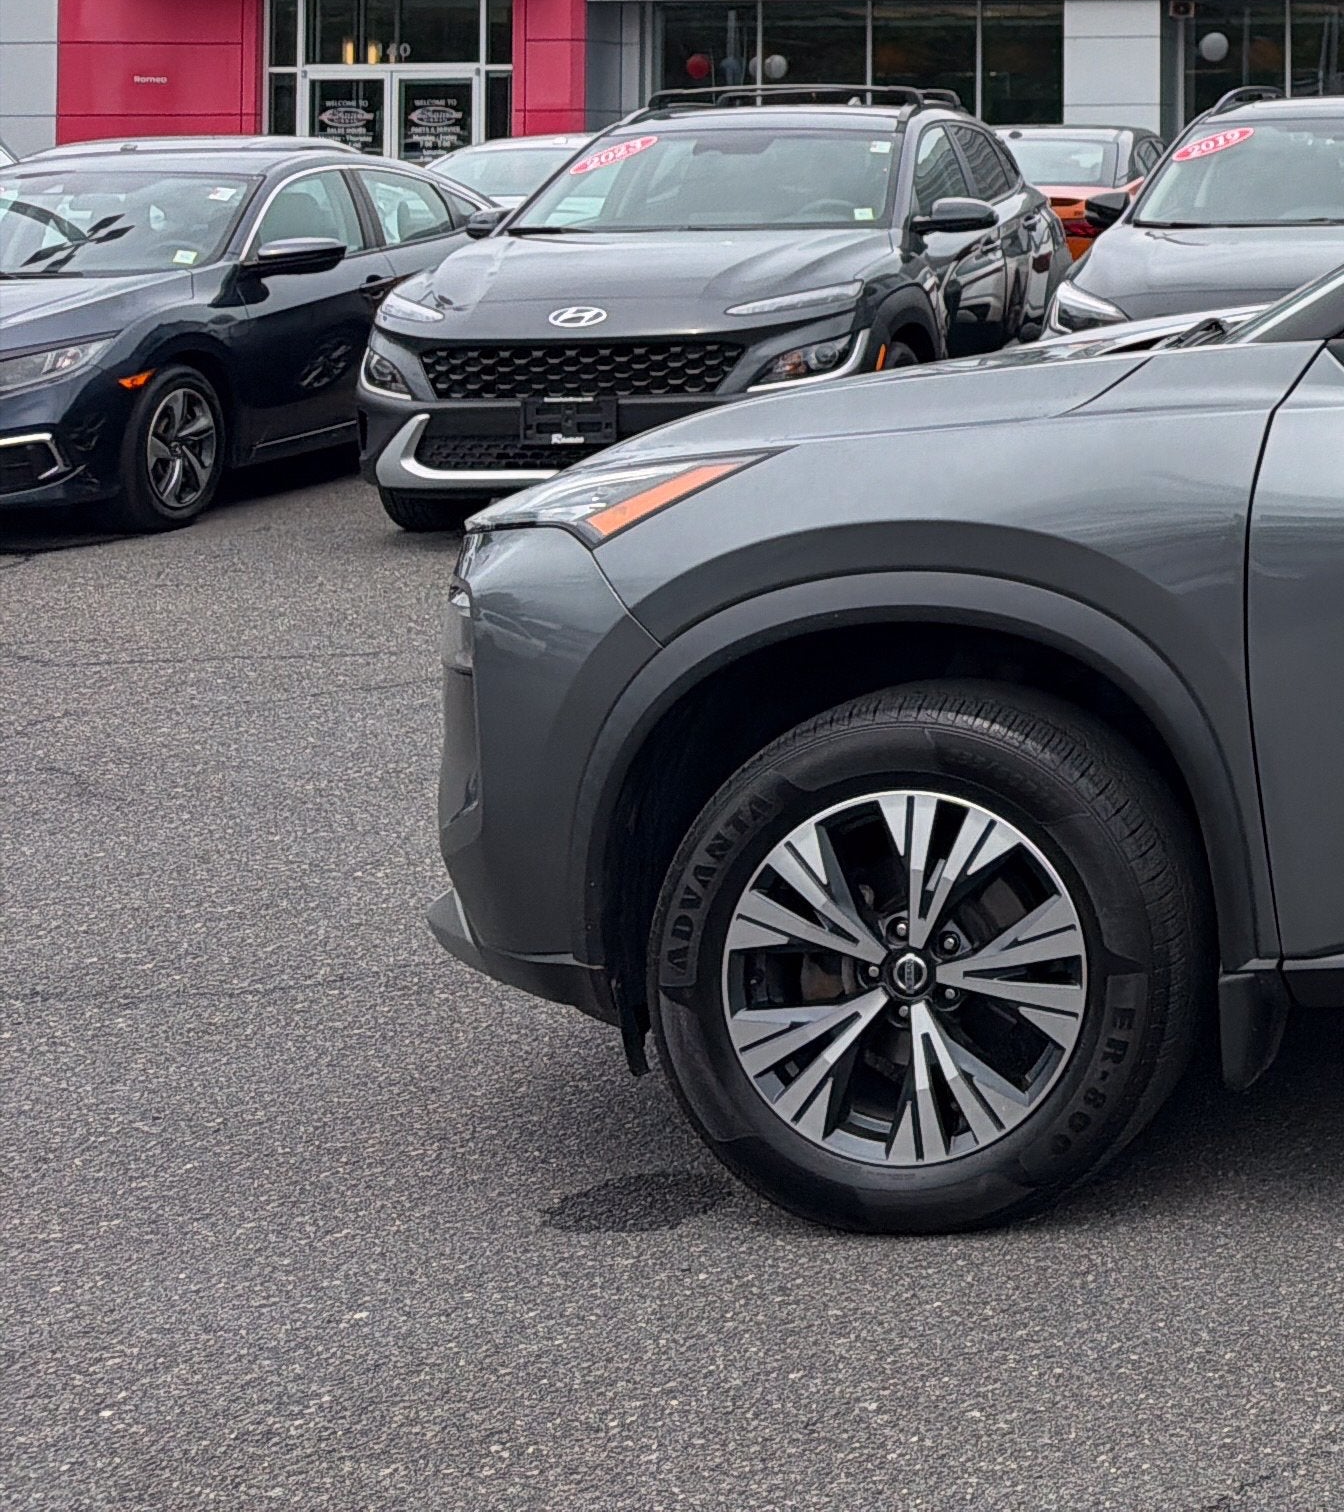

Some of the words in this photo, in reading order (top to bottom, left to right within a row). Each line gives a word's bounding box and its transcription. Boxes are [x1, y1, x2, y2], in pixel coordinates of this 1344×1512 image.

[133, 75, 168, 84] Romeo
[1187, 131, 1240, 156] 2019
[666, 791, 775, 976] ADVANTA
[1049, 1006, 1137, 1156] ER-800
